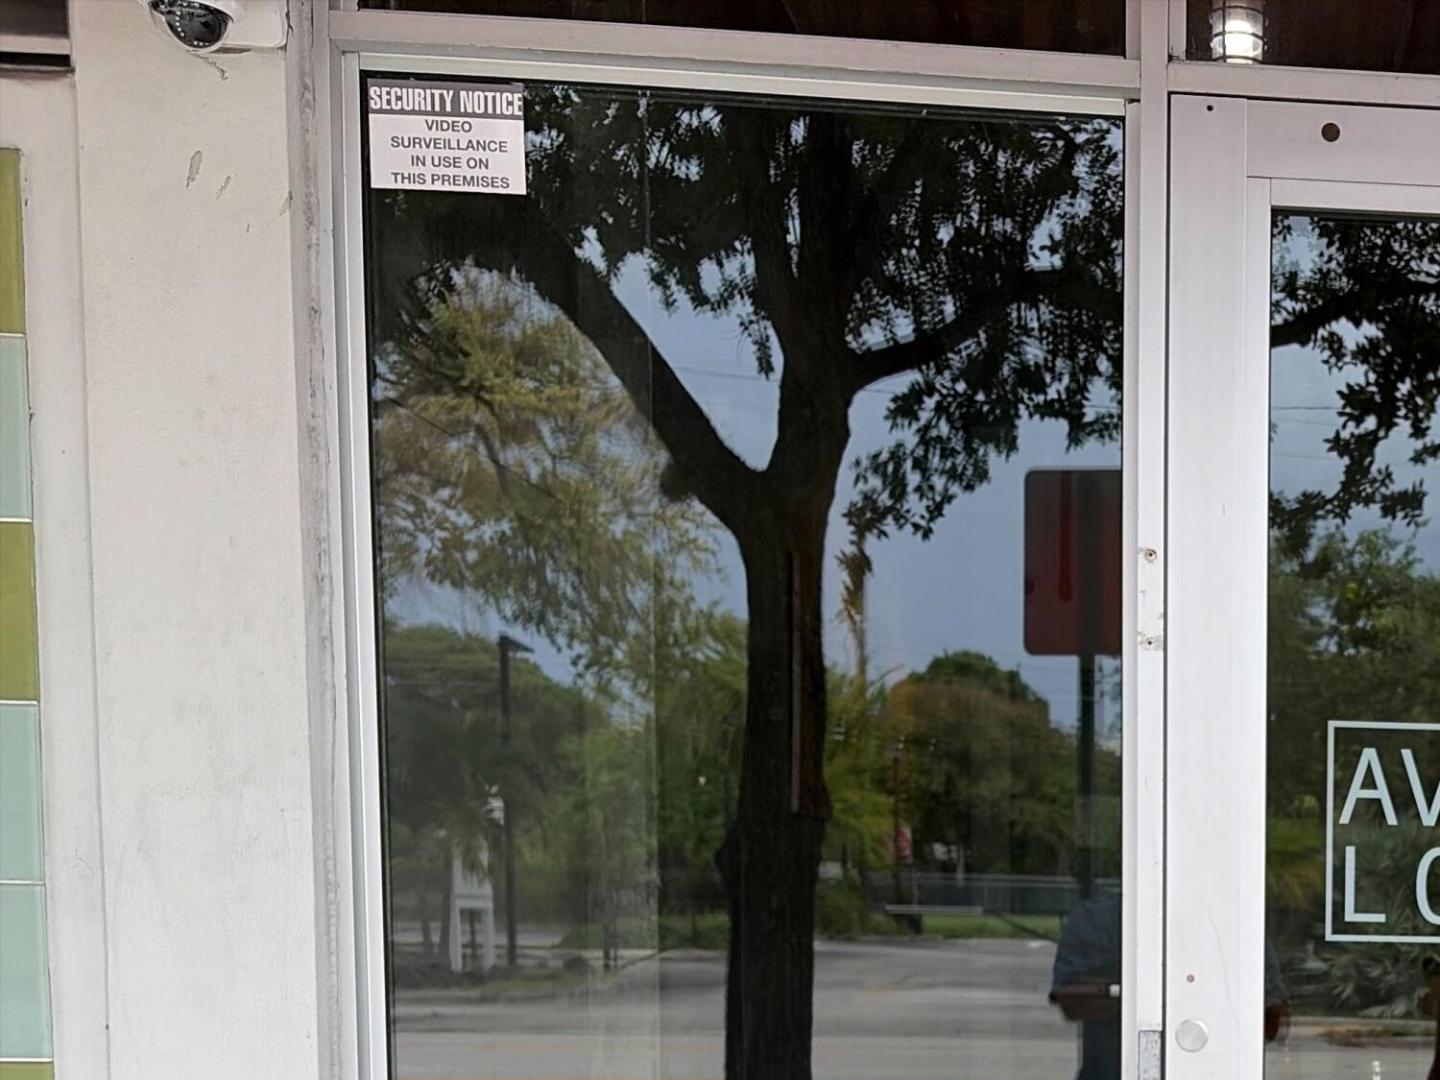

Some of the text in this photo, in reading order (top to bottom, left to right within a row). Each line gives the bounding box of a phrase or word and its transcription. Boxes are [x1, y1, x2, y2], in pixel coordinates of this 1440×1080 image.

[369, 86, 523, 115] SECURITY NOTICE
[425, 119, 472, 133] VIDEO
[391, 136, 508, 153] SURVEILLANCE
[411, 155, 489, 170] IN USE ON
[391, 172, 510, 189] THIS PREMISES
